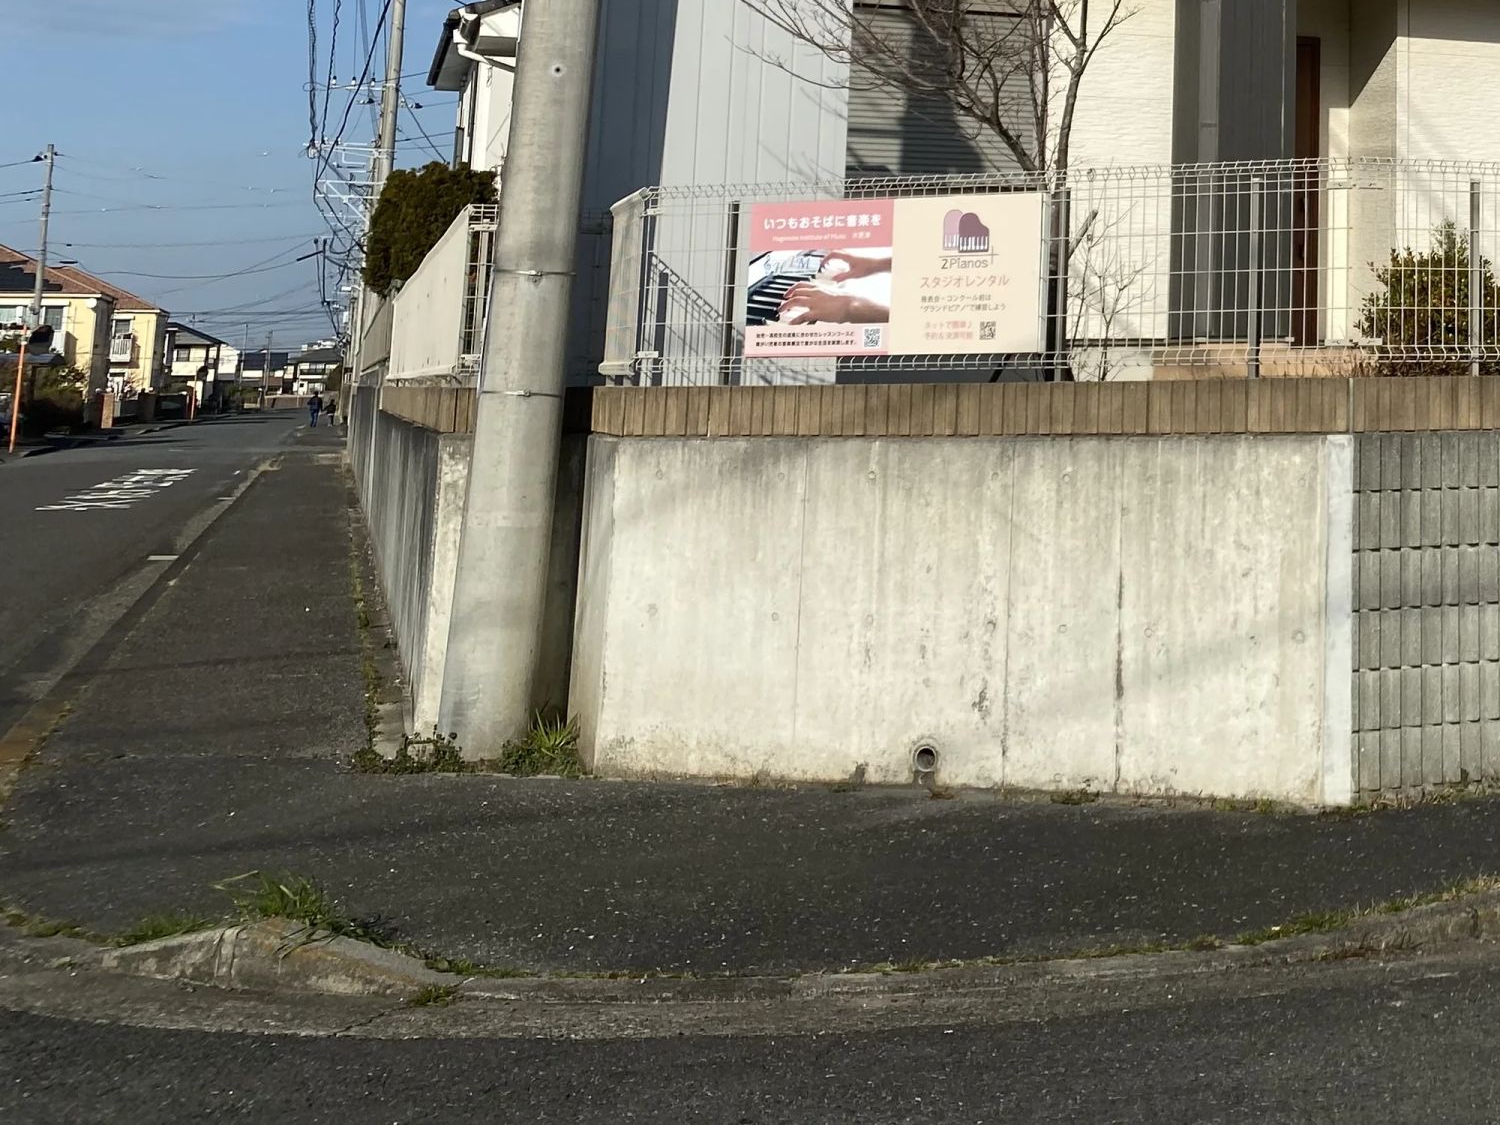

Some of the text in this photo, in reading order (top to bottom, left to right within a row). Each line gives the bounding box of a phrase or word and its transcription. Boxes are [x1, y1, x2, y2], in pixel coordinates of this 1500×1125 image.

[763, 214, 882, 230] いつもおそばに音楽を
[940, 257, 989, 270] 2Pianos
[920, 274, 1010, 288] スタジオレンタル
